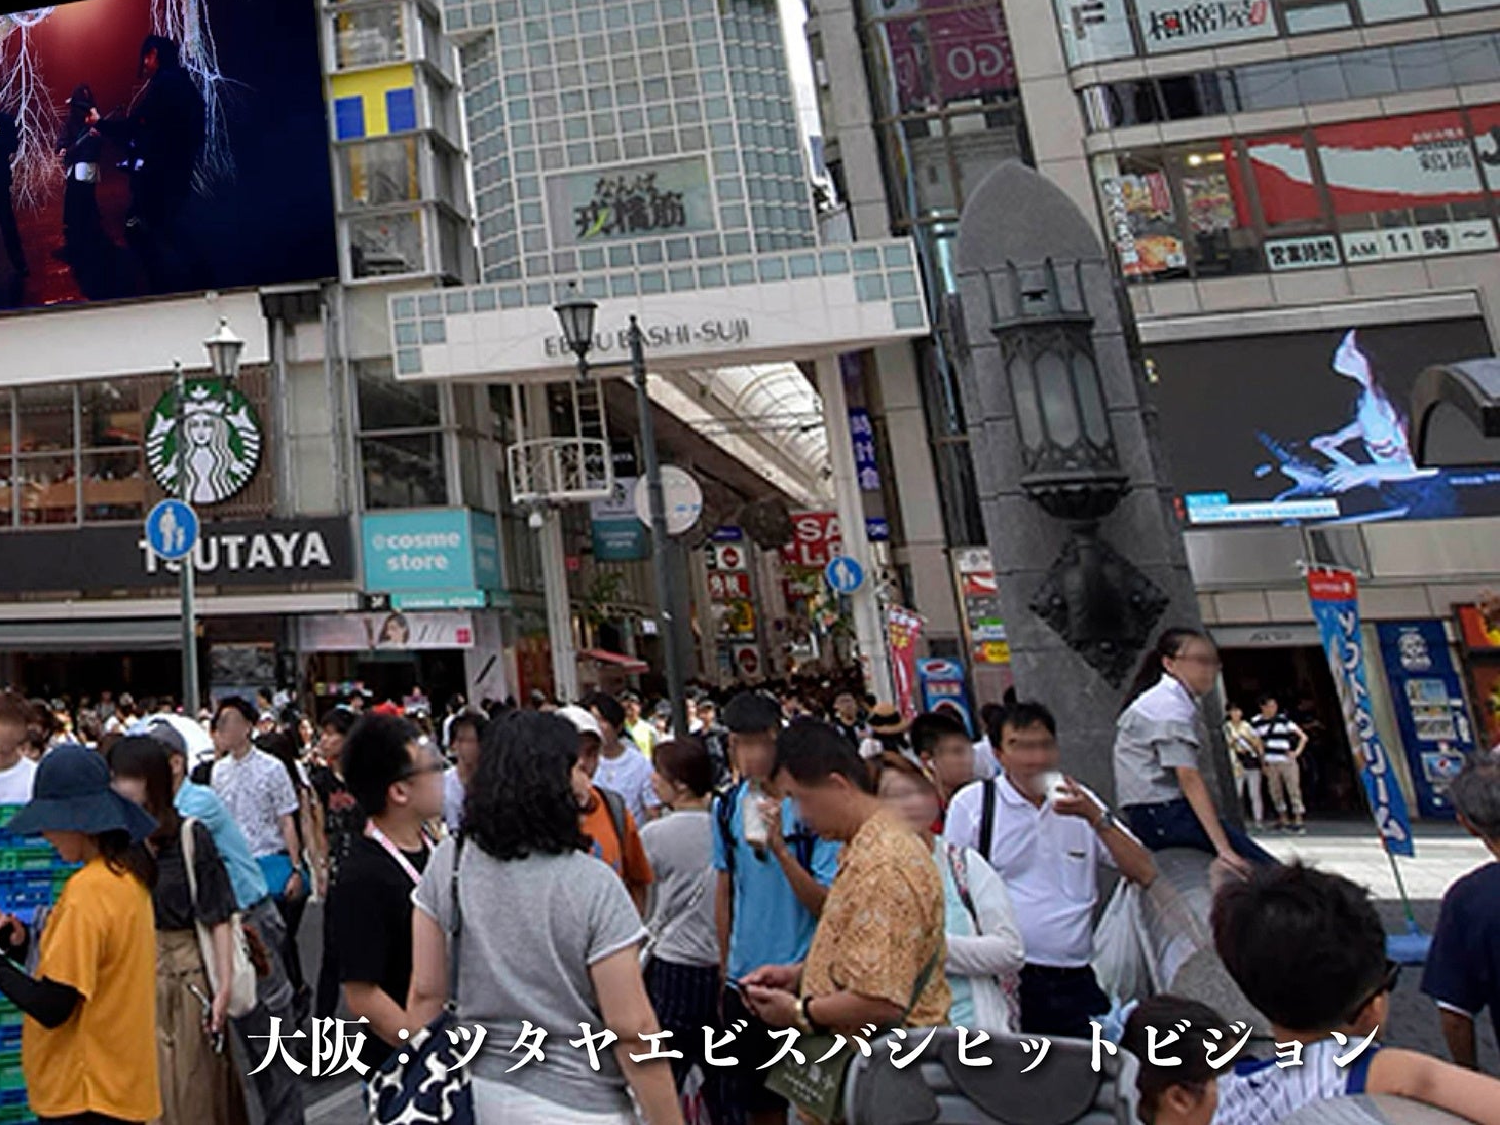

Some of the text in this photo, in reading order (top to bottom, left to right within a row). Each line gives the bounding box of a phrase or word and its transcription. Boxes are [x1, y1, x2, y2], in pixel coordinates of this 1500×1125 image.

[1350, 242, 1379, 258] AM
[140, 531, 331, 573] TUTAYA
[386, 553, 449, 571] store
